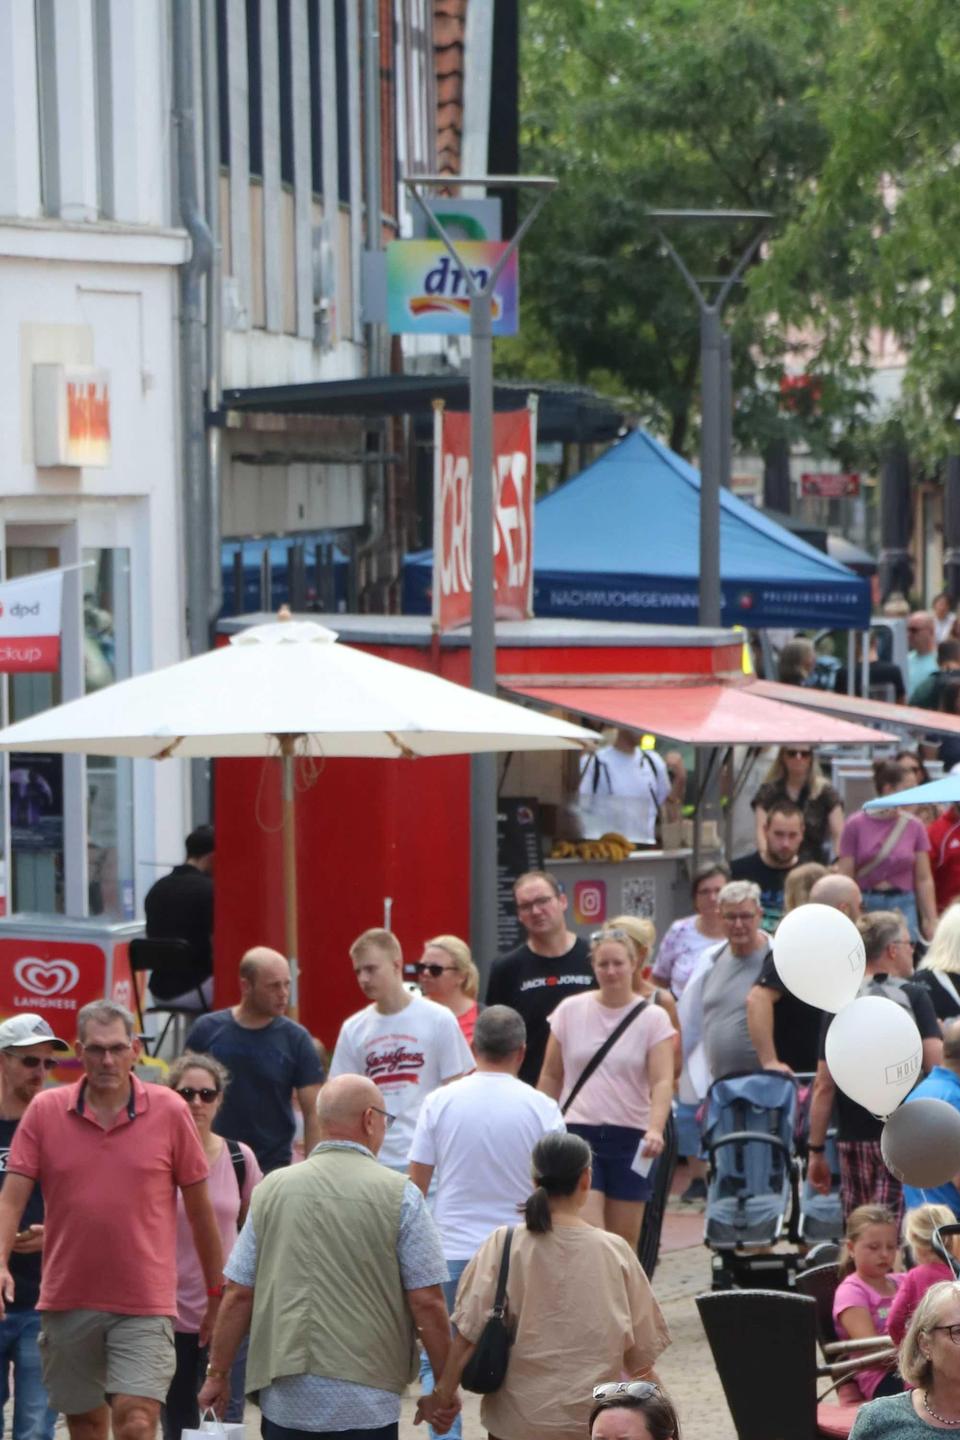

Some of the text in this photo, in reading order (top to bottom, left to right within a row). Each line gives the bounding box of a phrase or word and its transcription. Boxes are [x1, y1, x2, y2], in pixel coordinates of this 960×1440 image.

[424, 256, 489, 295] dm
[10, 602, 40, 619] dpd
[13, 997, 77, 1010] LANGNESE
